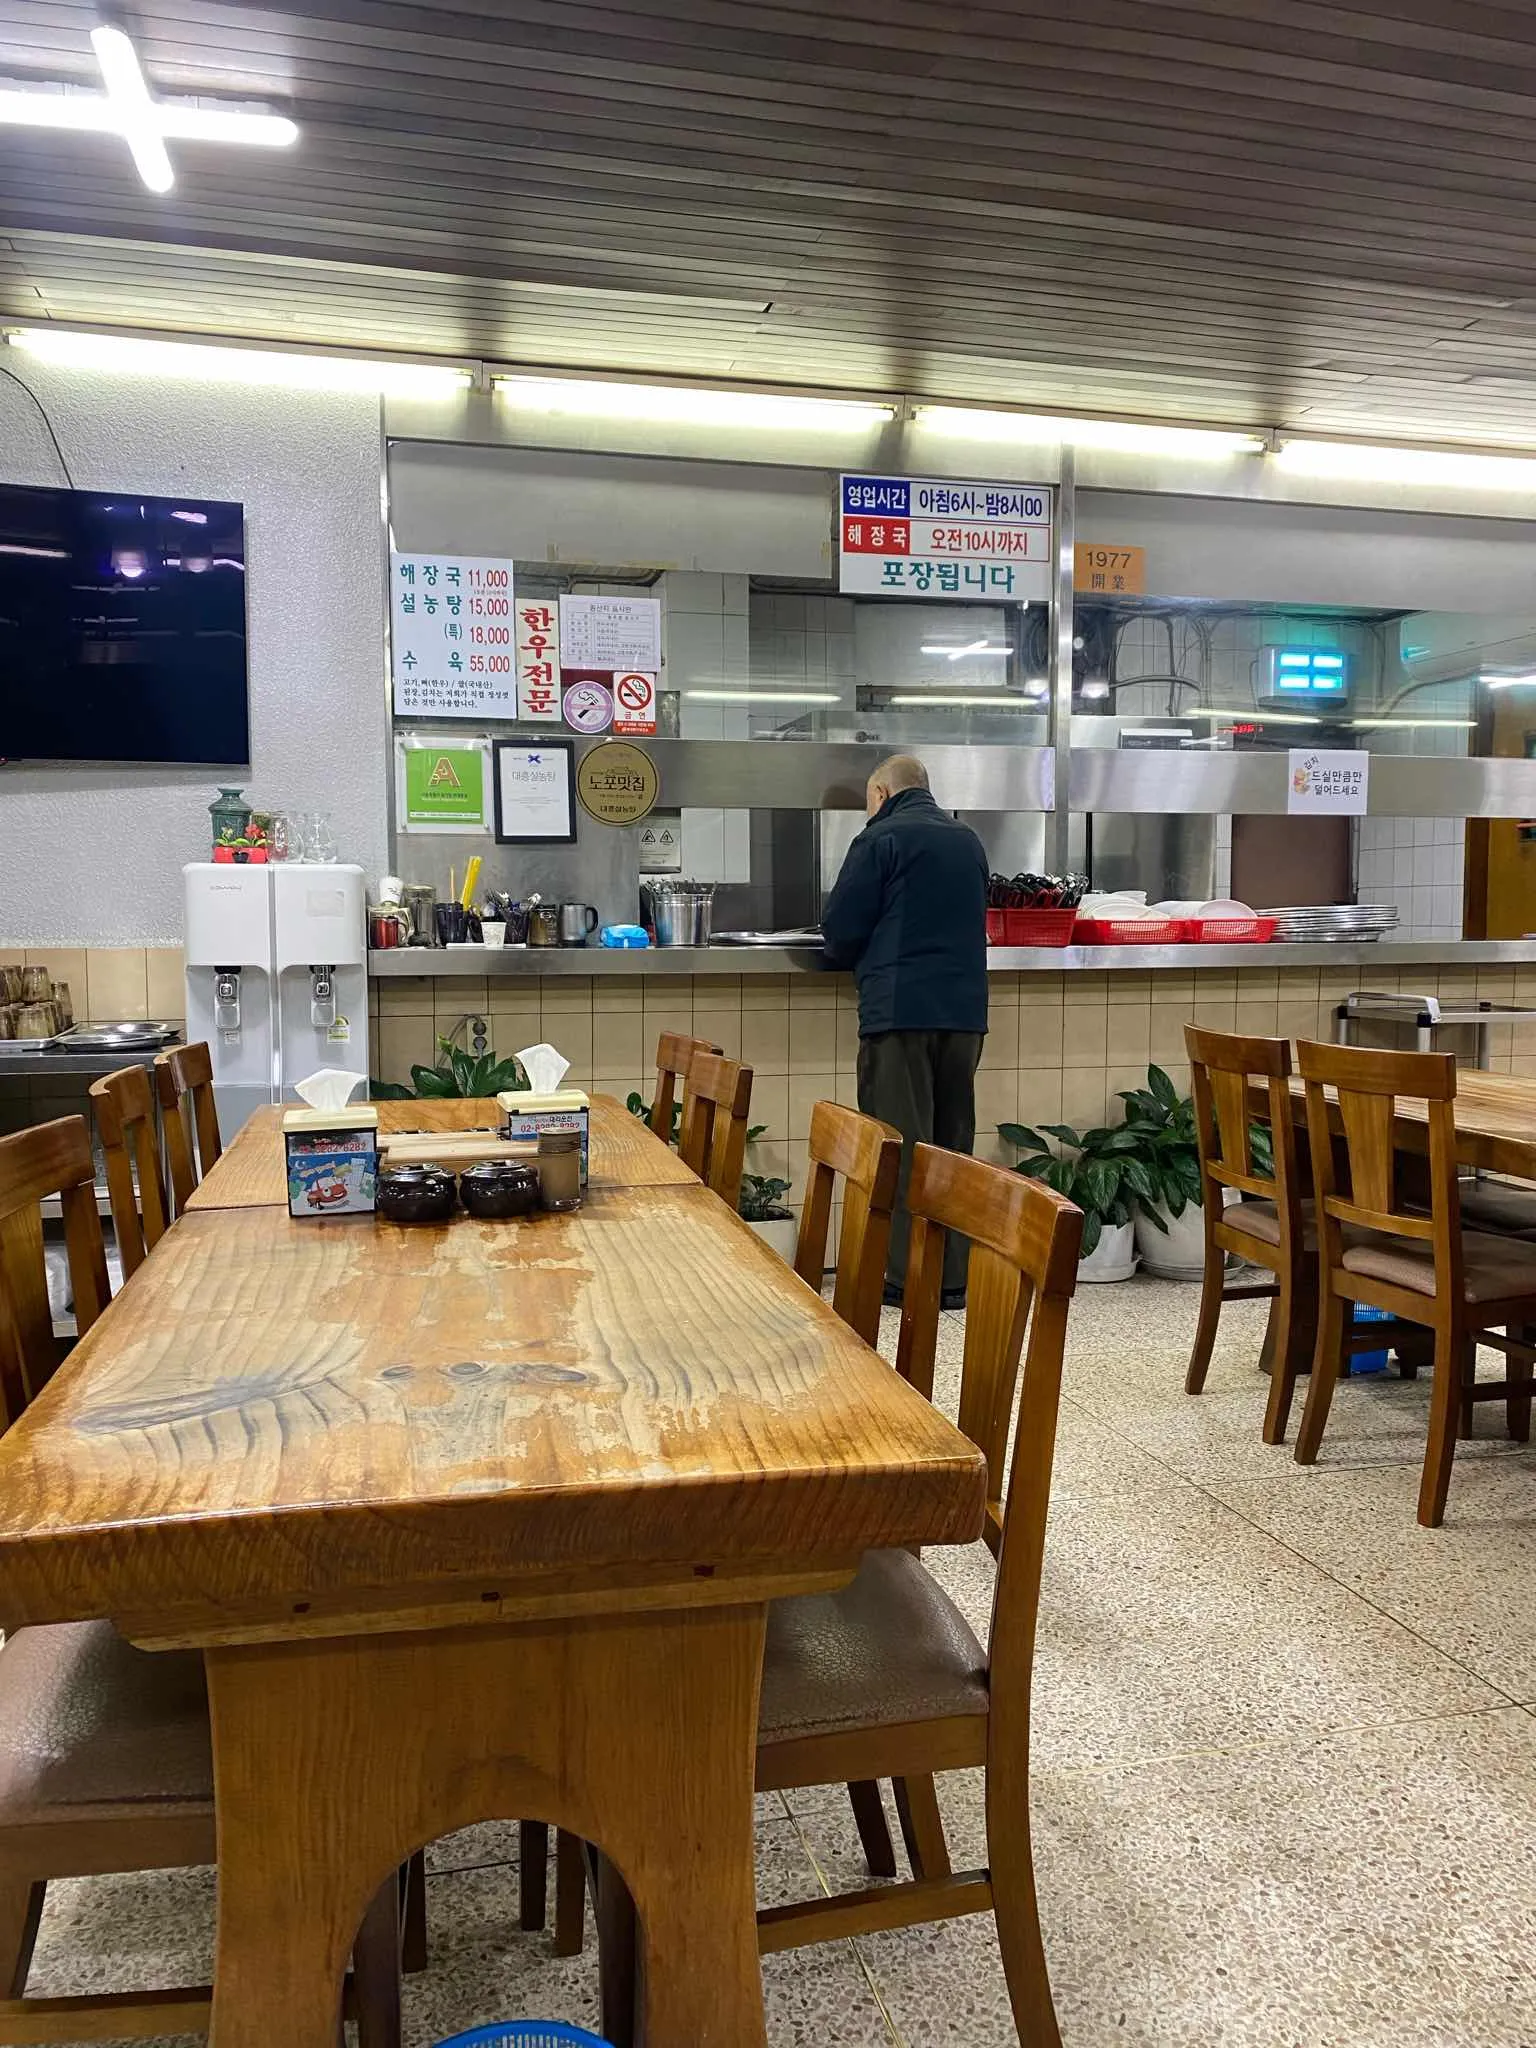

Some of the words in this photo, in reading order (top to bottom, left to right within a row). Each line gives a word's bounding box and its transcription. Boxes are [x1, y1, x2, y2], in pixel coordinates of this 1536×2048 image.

[847, 485, 907, 510] 영업시간
[919, 488, 1042, 517] 아침6시~밤8시00
[930, 529, 1028, 556] 오전10시까지
[1087, 551, 1131, 568] 1977
[468, 569, 509, 588] 11,000
[880, 560, 1016, 594] 포장됩니다
[468, 598, 509, 616] 15,000
[444, 623, 463, 641] (특)
[470, 626, 510, 646] 18,000
[470, 655, 510, 674] 55,000
[520, 607, 559, 714] 한우전문
[588, 775, 645, 792] 노포맛집
[1312, 770, 1362, 783] 드실만큼만
[1314, 784, 1359, 796] 덜어드세요
